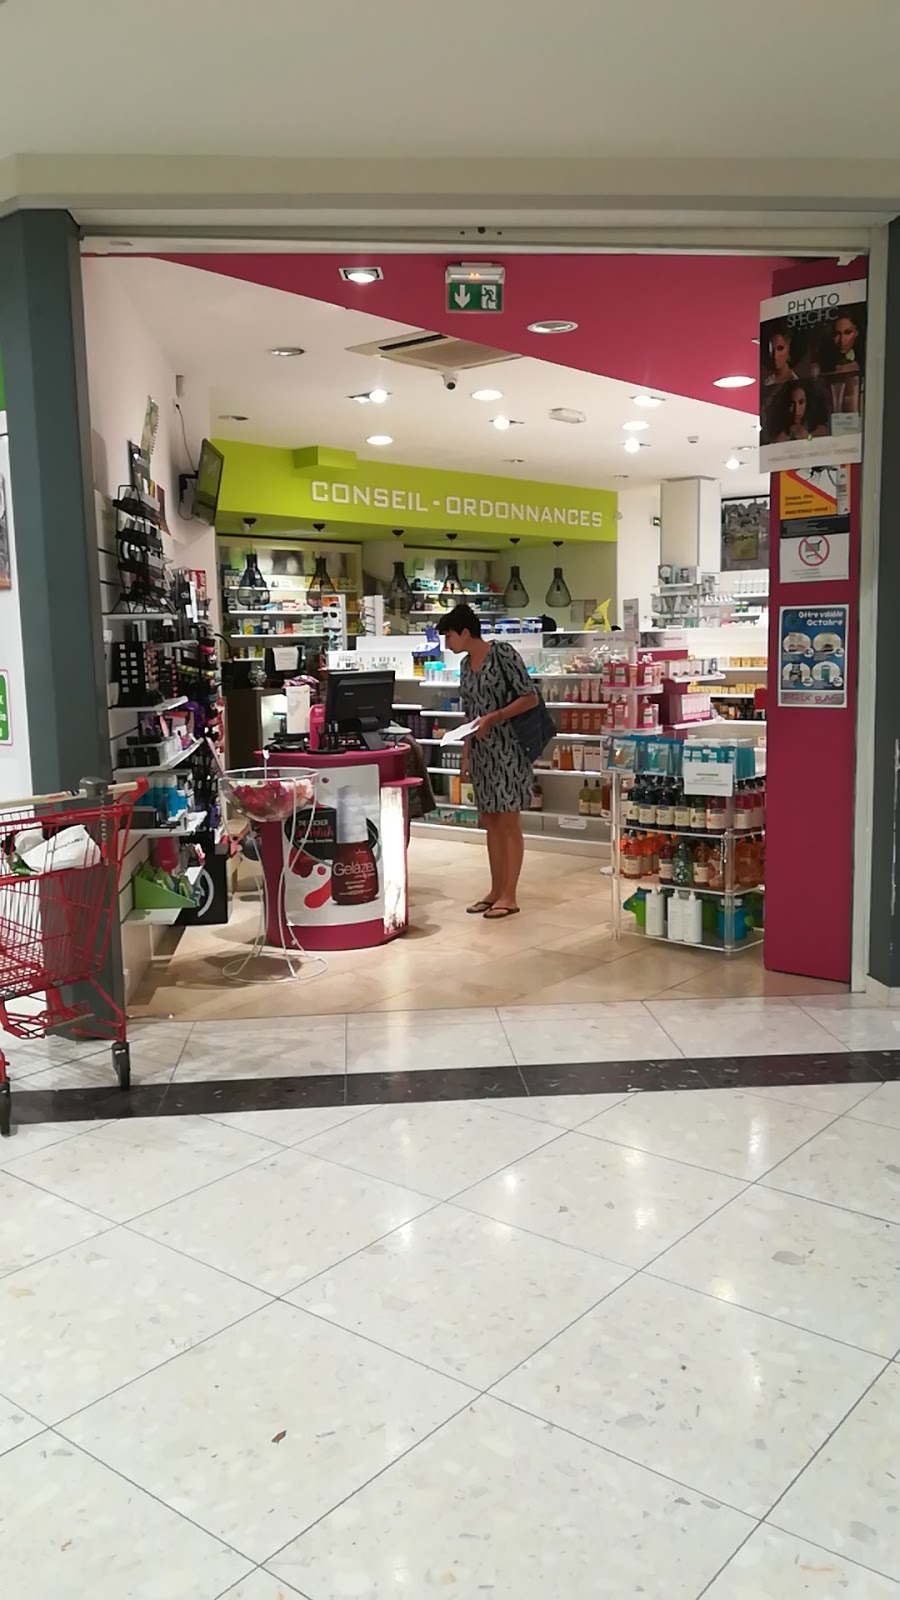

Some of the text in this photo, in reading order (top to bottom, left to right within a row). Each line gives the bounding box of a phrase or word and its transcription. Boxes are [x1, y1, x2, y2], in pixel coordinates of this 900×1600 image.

[787, 293, 840, 313] PHYTO
[787, 306, 839, 328] SPECIFIC
[806, 618, 843, 626] Octobre
